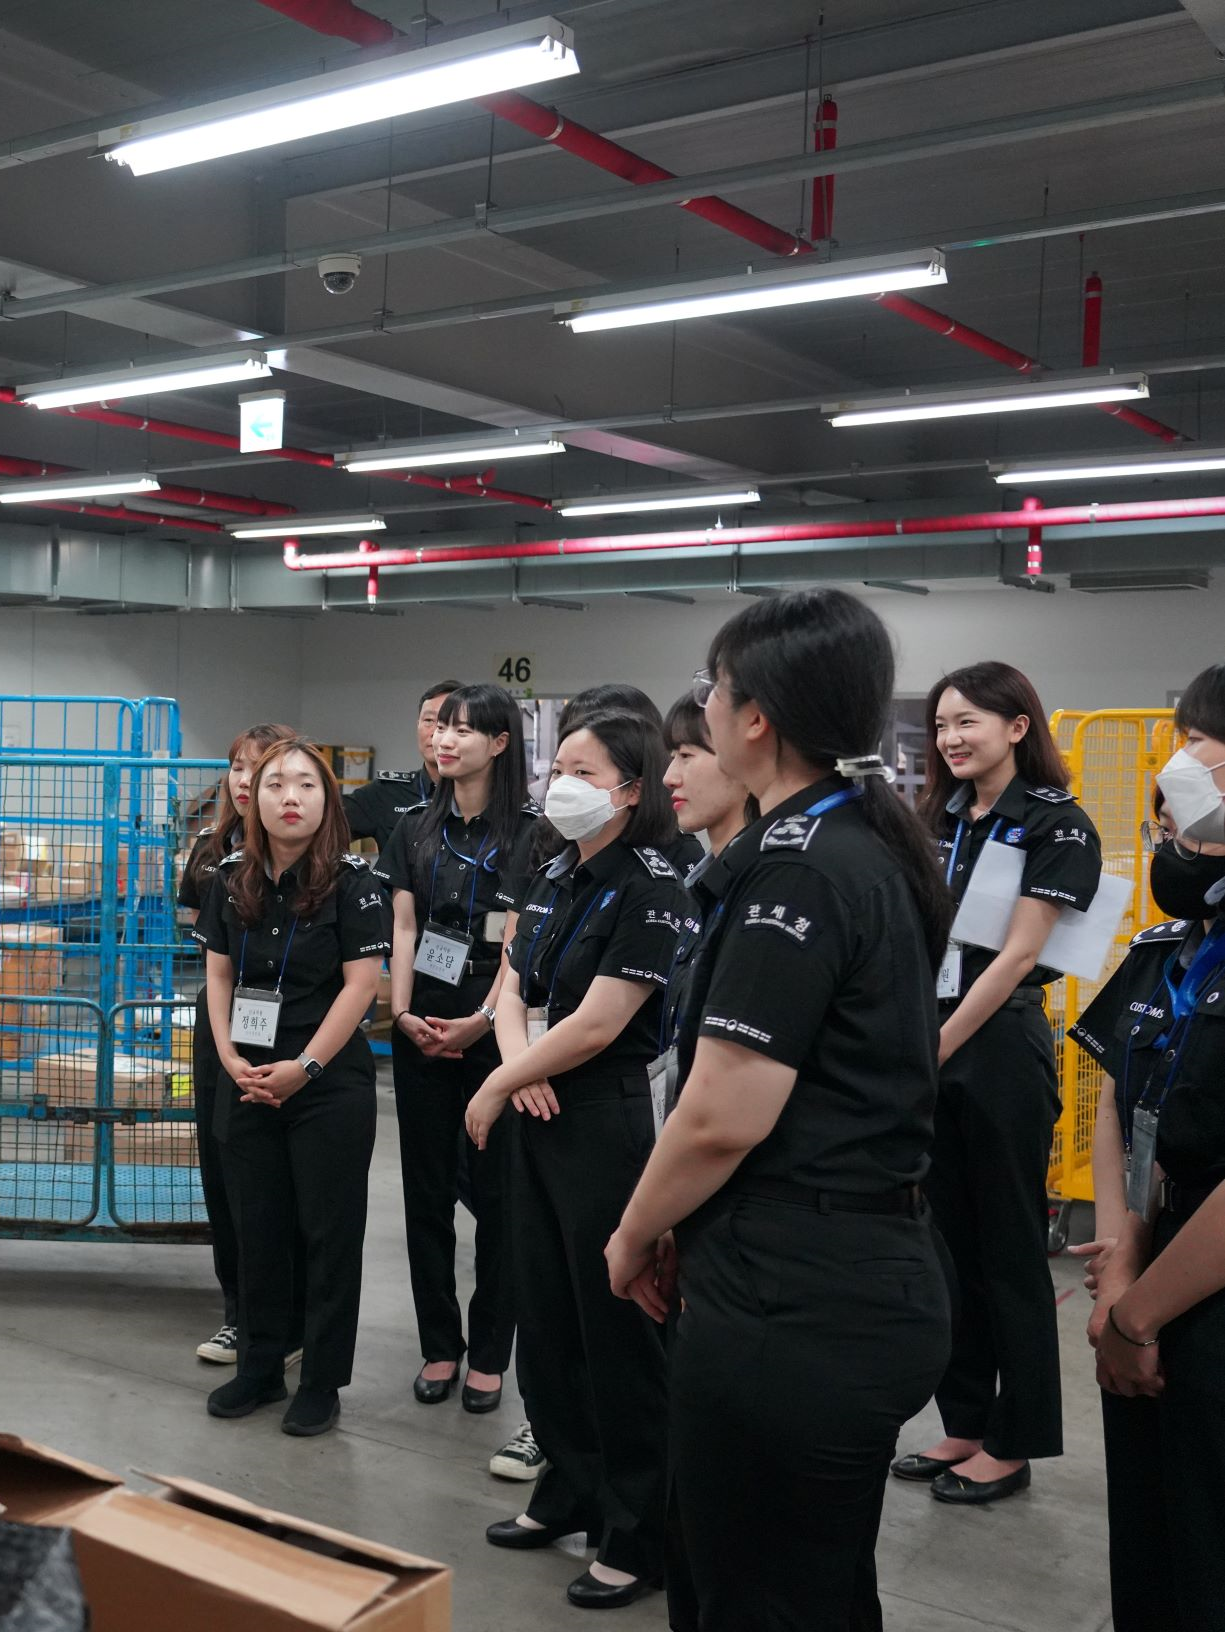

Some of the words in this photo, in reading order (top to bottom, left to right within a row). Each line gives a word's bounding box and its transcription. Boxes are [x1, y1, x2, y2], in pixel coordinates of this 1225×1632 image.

[498, 657, 531, 683] 46
[746, 904, 811, 933] 관세청
[426, 949, 455, 969] 윤소담
[1129, 1001, 1165, 1019] CUSTOMS
[242, 1015, 267, 1031] 정희주
